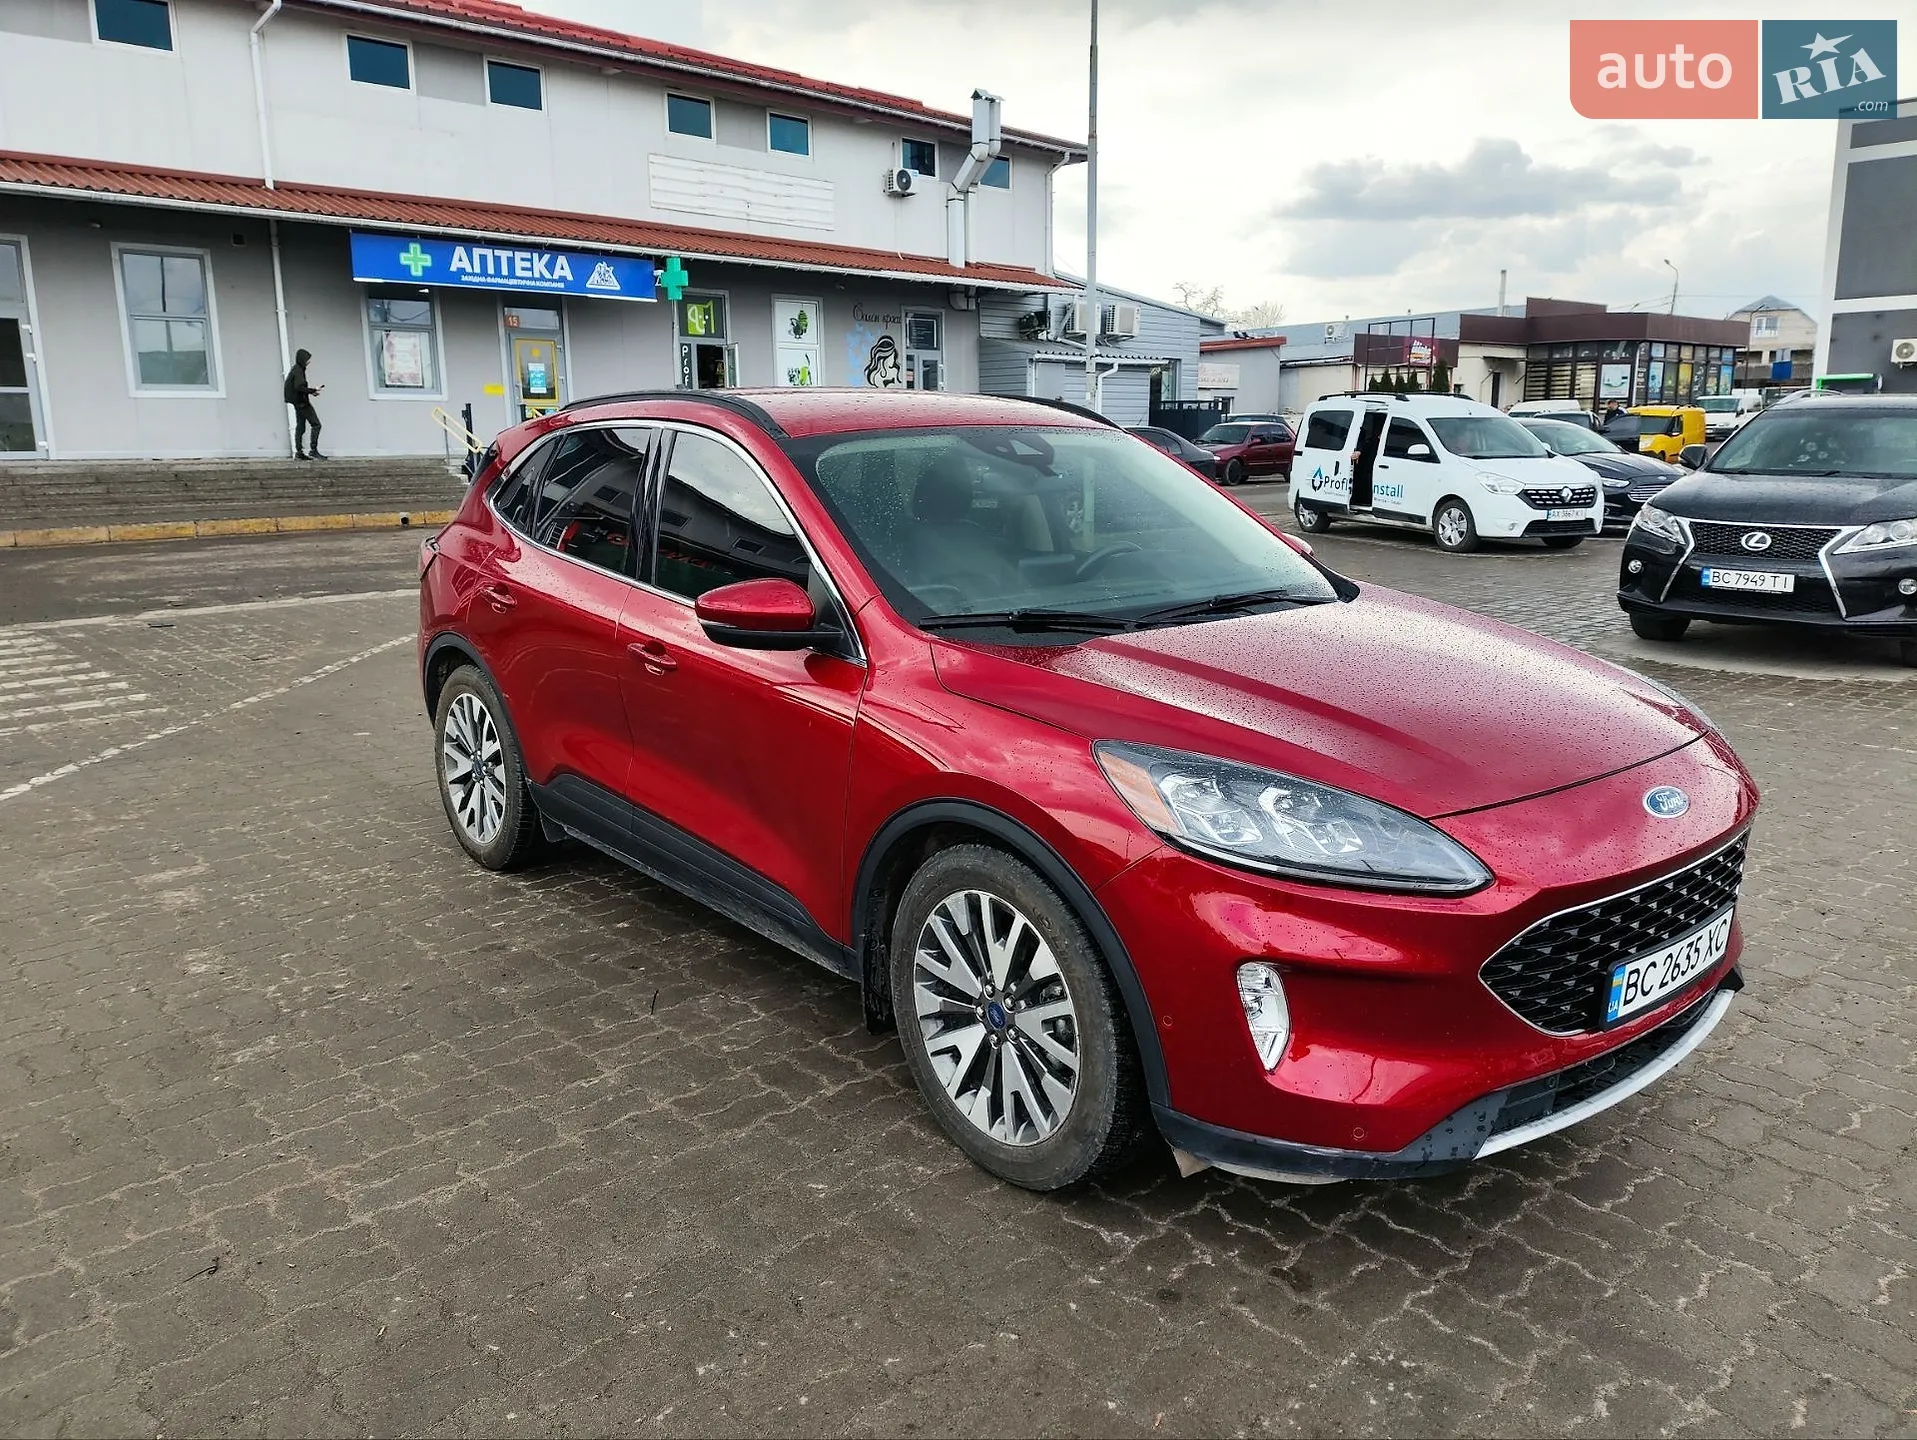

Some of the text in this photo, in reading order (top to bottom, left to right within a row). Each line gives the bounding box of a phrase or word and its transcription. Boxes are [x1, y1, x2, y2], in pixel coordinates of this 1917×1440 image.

[450, 246, 574, 281] АПТЕКА
[1711, 571, 1731, 584] BC
[1735, 573, 1766, 587] 7949
[1623, 919, 1728, 1006] BC 2635 XC
[1608, 1000, 1619, 1013] UA
